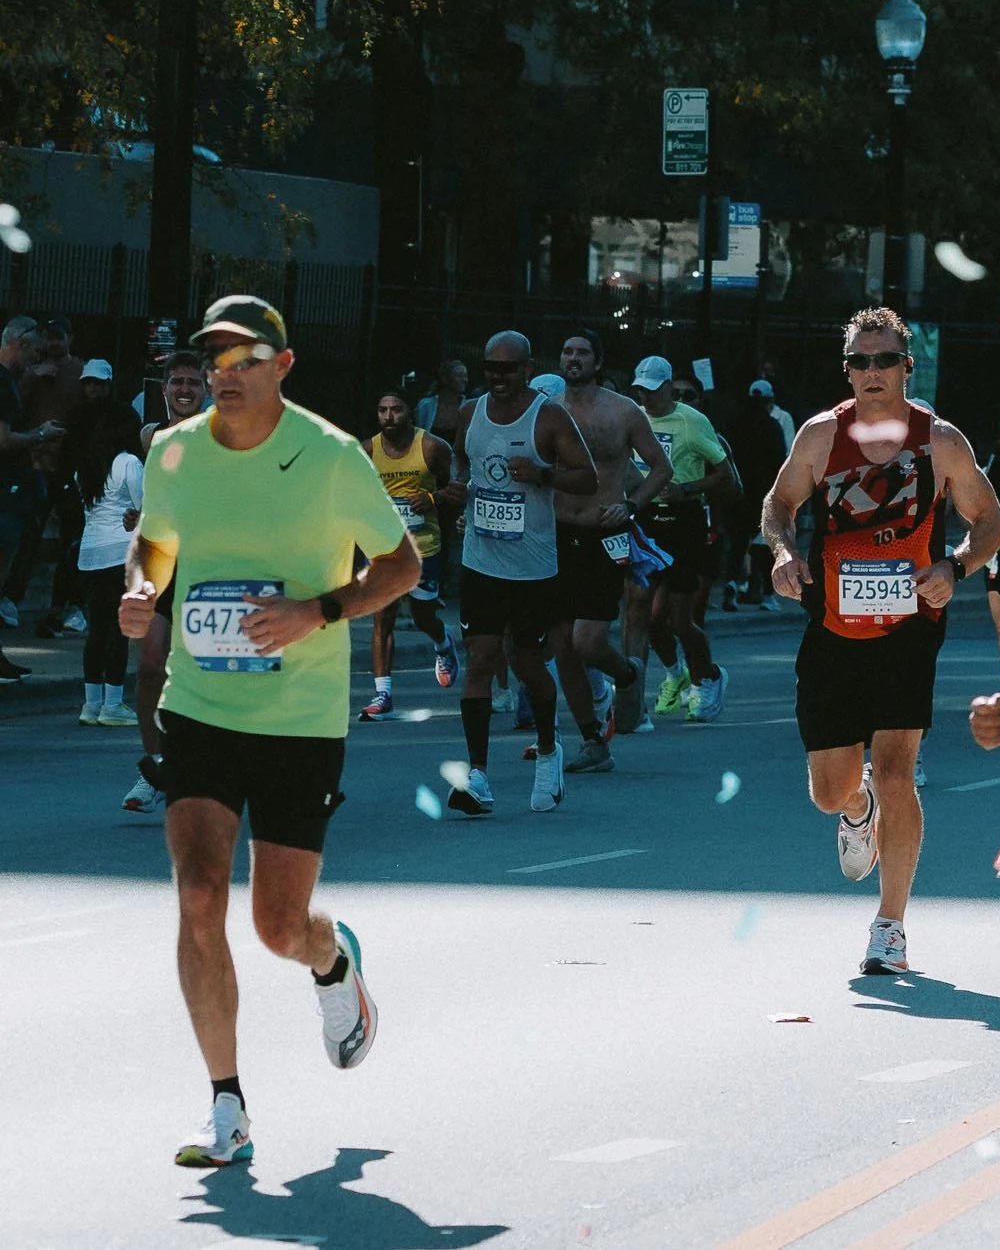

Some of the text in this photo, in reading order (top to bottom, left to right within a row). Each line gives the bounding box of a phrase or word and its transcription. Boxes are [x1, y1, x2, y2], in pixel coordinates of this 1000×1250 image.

[738, 206, 755, 214] bus
[738, 214, 758, 223] stop
[476, 501, 522, 521] E12853
[875, 528, 895, 545] 10
[842, 578, 914, 600] F25943
